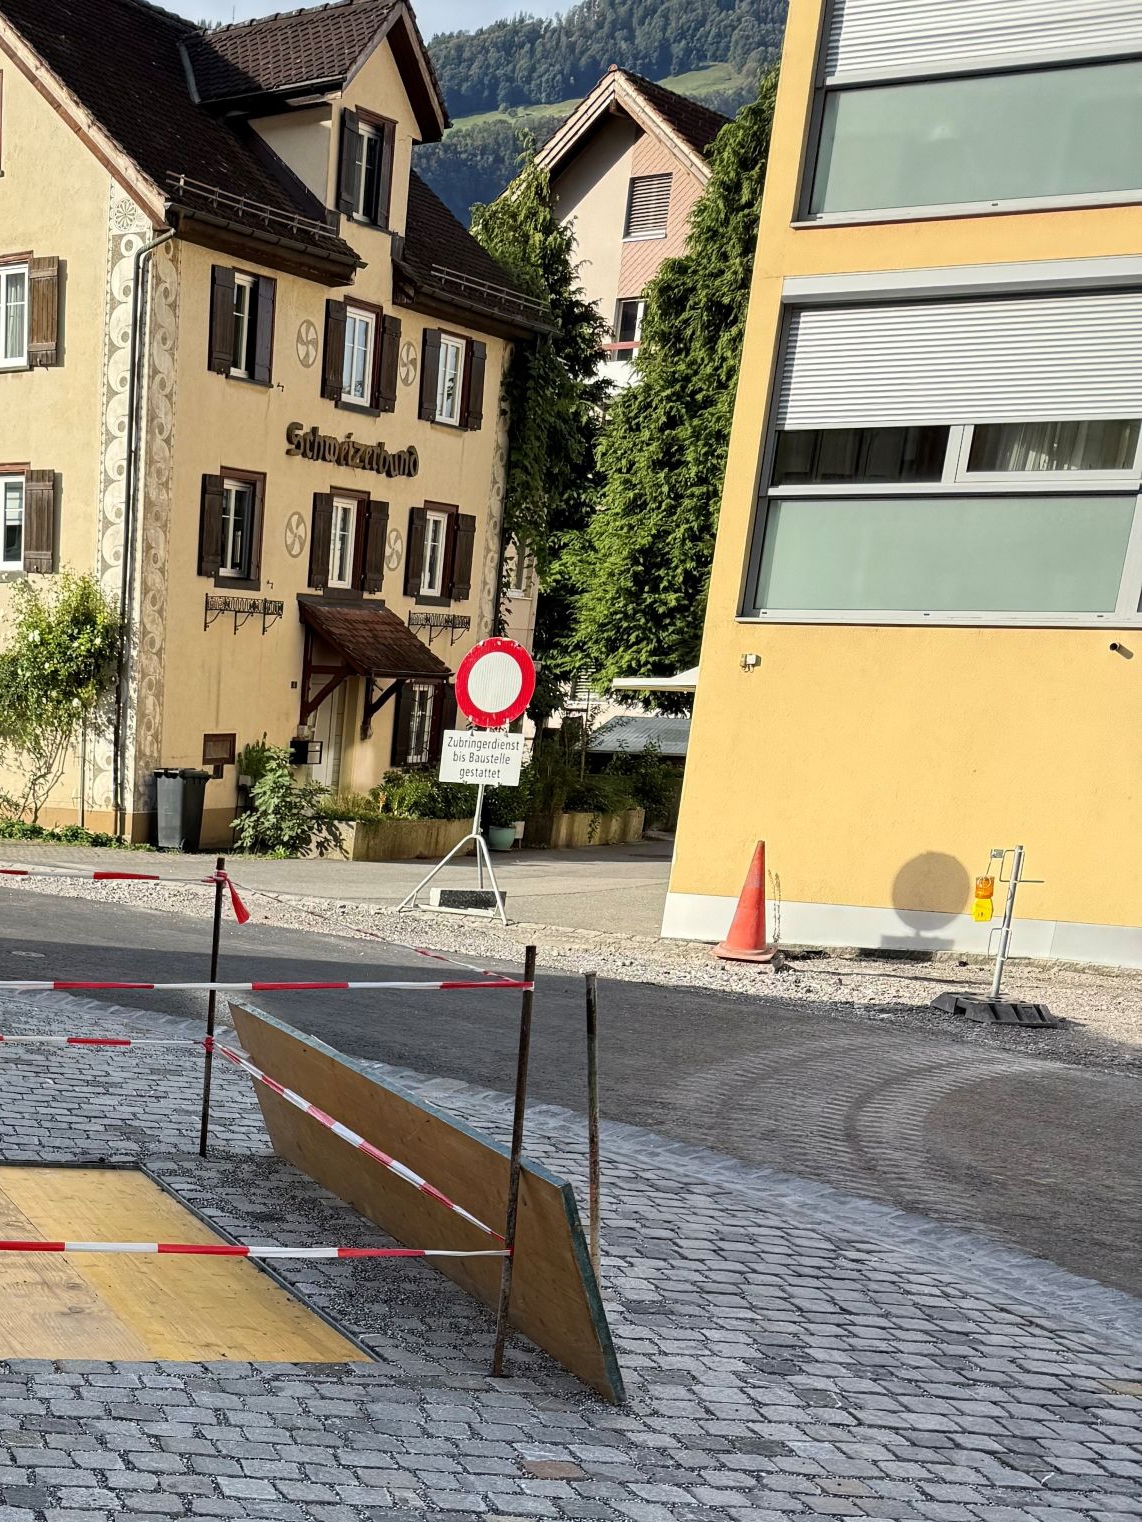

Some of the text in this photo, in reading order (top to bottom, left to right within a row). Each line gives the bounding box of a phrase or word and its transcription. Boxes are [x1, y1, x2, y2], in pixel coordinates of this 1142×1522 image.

[285, 421, 420, 478] Schweizerbund
[447, 736, 520, 752] Zubringerdienst
[452, 751, 511, 765] bis Baustelle
[459, 767, 501, 780] gestattet
